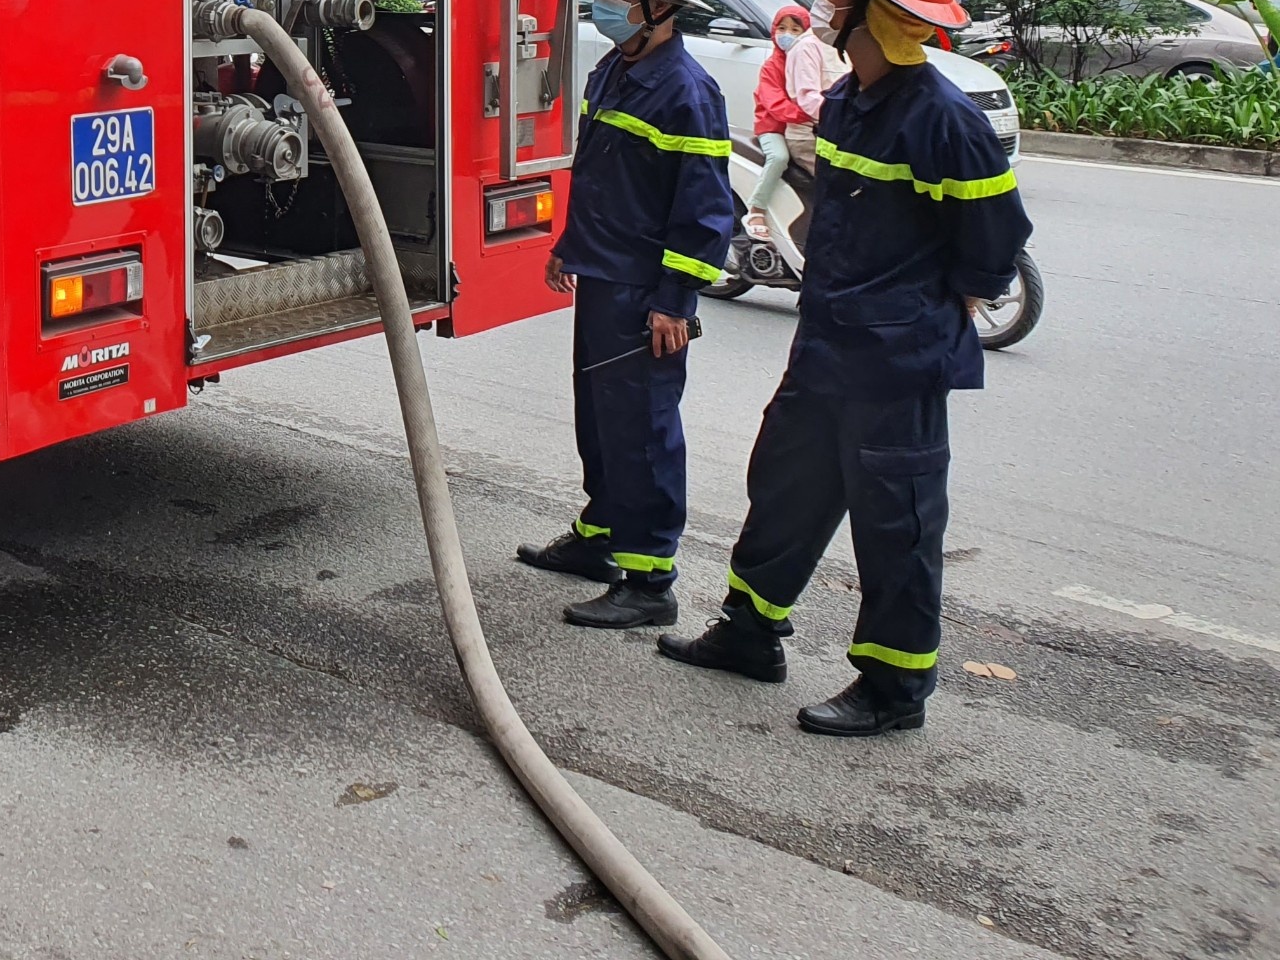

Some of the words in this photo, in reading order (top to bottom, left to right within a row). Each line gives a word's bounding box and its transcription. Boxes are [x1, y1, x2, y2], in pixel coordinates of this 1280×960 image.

[91, 114, 135, 156] 29A
[75, 153, 152, 200] 006.42
[61, 342, 130, 372] MORITA
[63, 378, 85, 391] MORITA
[86, 367, 125, 385] CORPORATION
